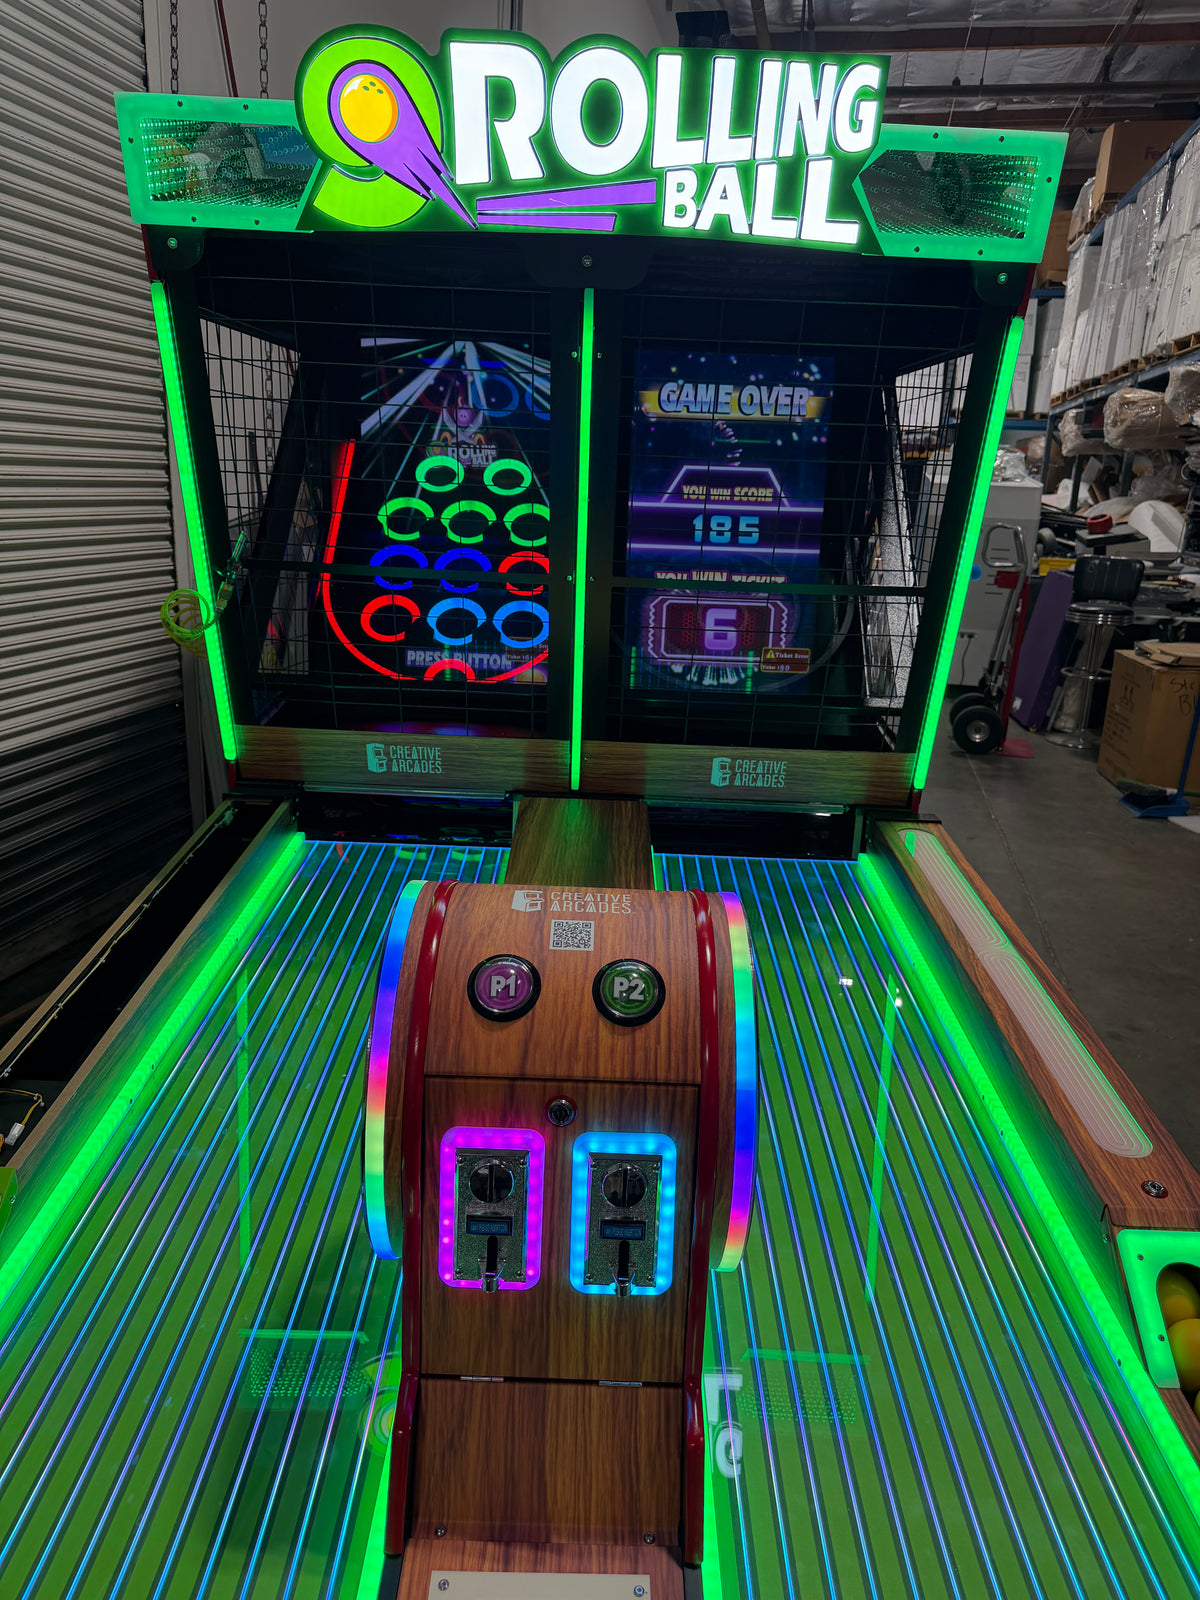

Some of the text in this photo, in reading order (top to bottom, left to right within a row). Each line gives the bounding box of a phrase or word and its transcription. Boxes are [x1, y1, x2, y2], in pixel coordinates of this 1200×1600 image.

[449, 41, 881, 185] ROLLING
[662, 156, 860, 244] BALL
[660, 382, 809, 417] GAME OVER
[682, 485, 774, 502] YOU WIN SCORE
[692, 514, 760, 545] 185
[704, 608, 738, 650] 6
[406, 650, 449, 667] PRESS
[389, 744, 442, 761] CREATIVE
[391, 759, 443, 775] ARCADES
[735, 759, 788, 775] CREATIVE
[733, 773, 786, 789] ARCADES
[550, 891, 632, 904] CREATIVE
[549, 900, 633, 914] ARCADES
[489, 974, 517, 998] P1
[612, 976, 646, 1002] P2
